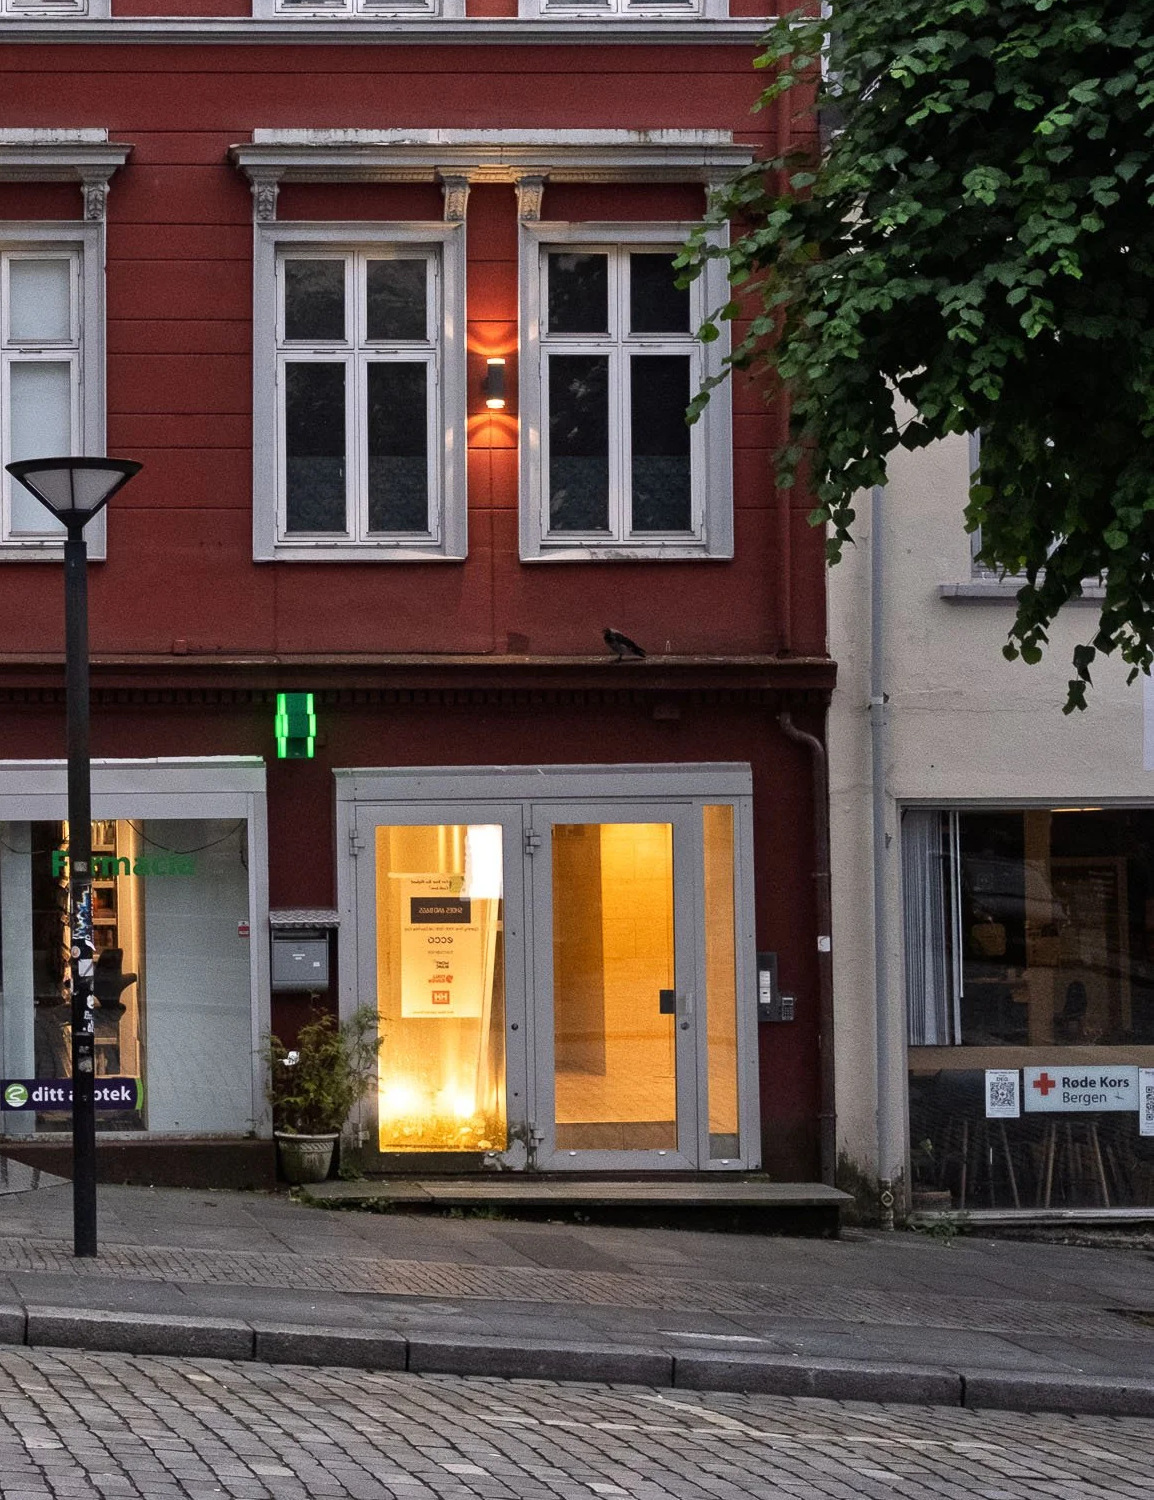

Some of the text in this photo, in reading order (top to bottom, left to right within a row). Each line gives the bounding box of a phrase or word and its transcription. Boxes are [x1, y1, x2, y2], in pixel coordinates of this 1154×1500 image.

[51, 849, 195, 877] Frmacia
[1062, 1076, 1130, 1088] Røde Kors
[32, 1086, 132, 1102] ditt otek
[1062, 1092, 1107, 1106] Bergen
